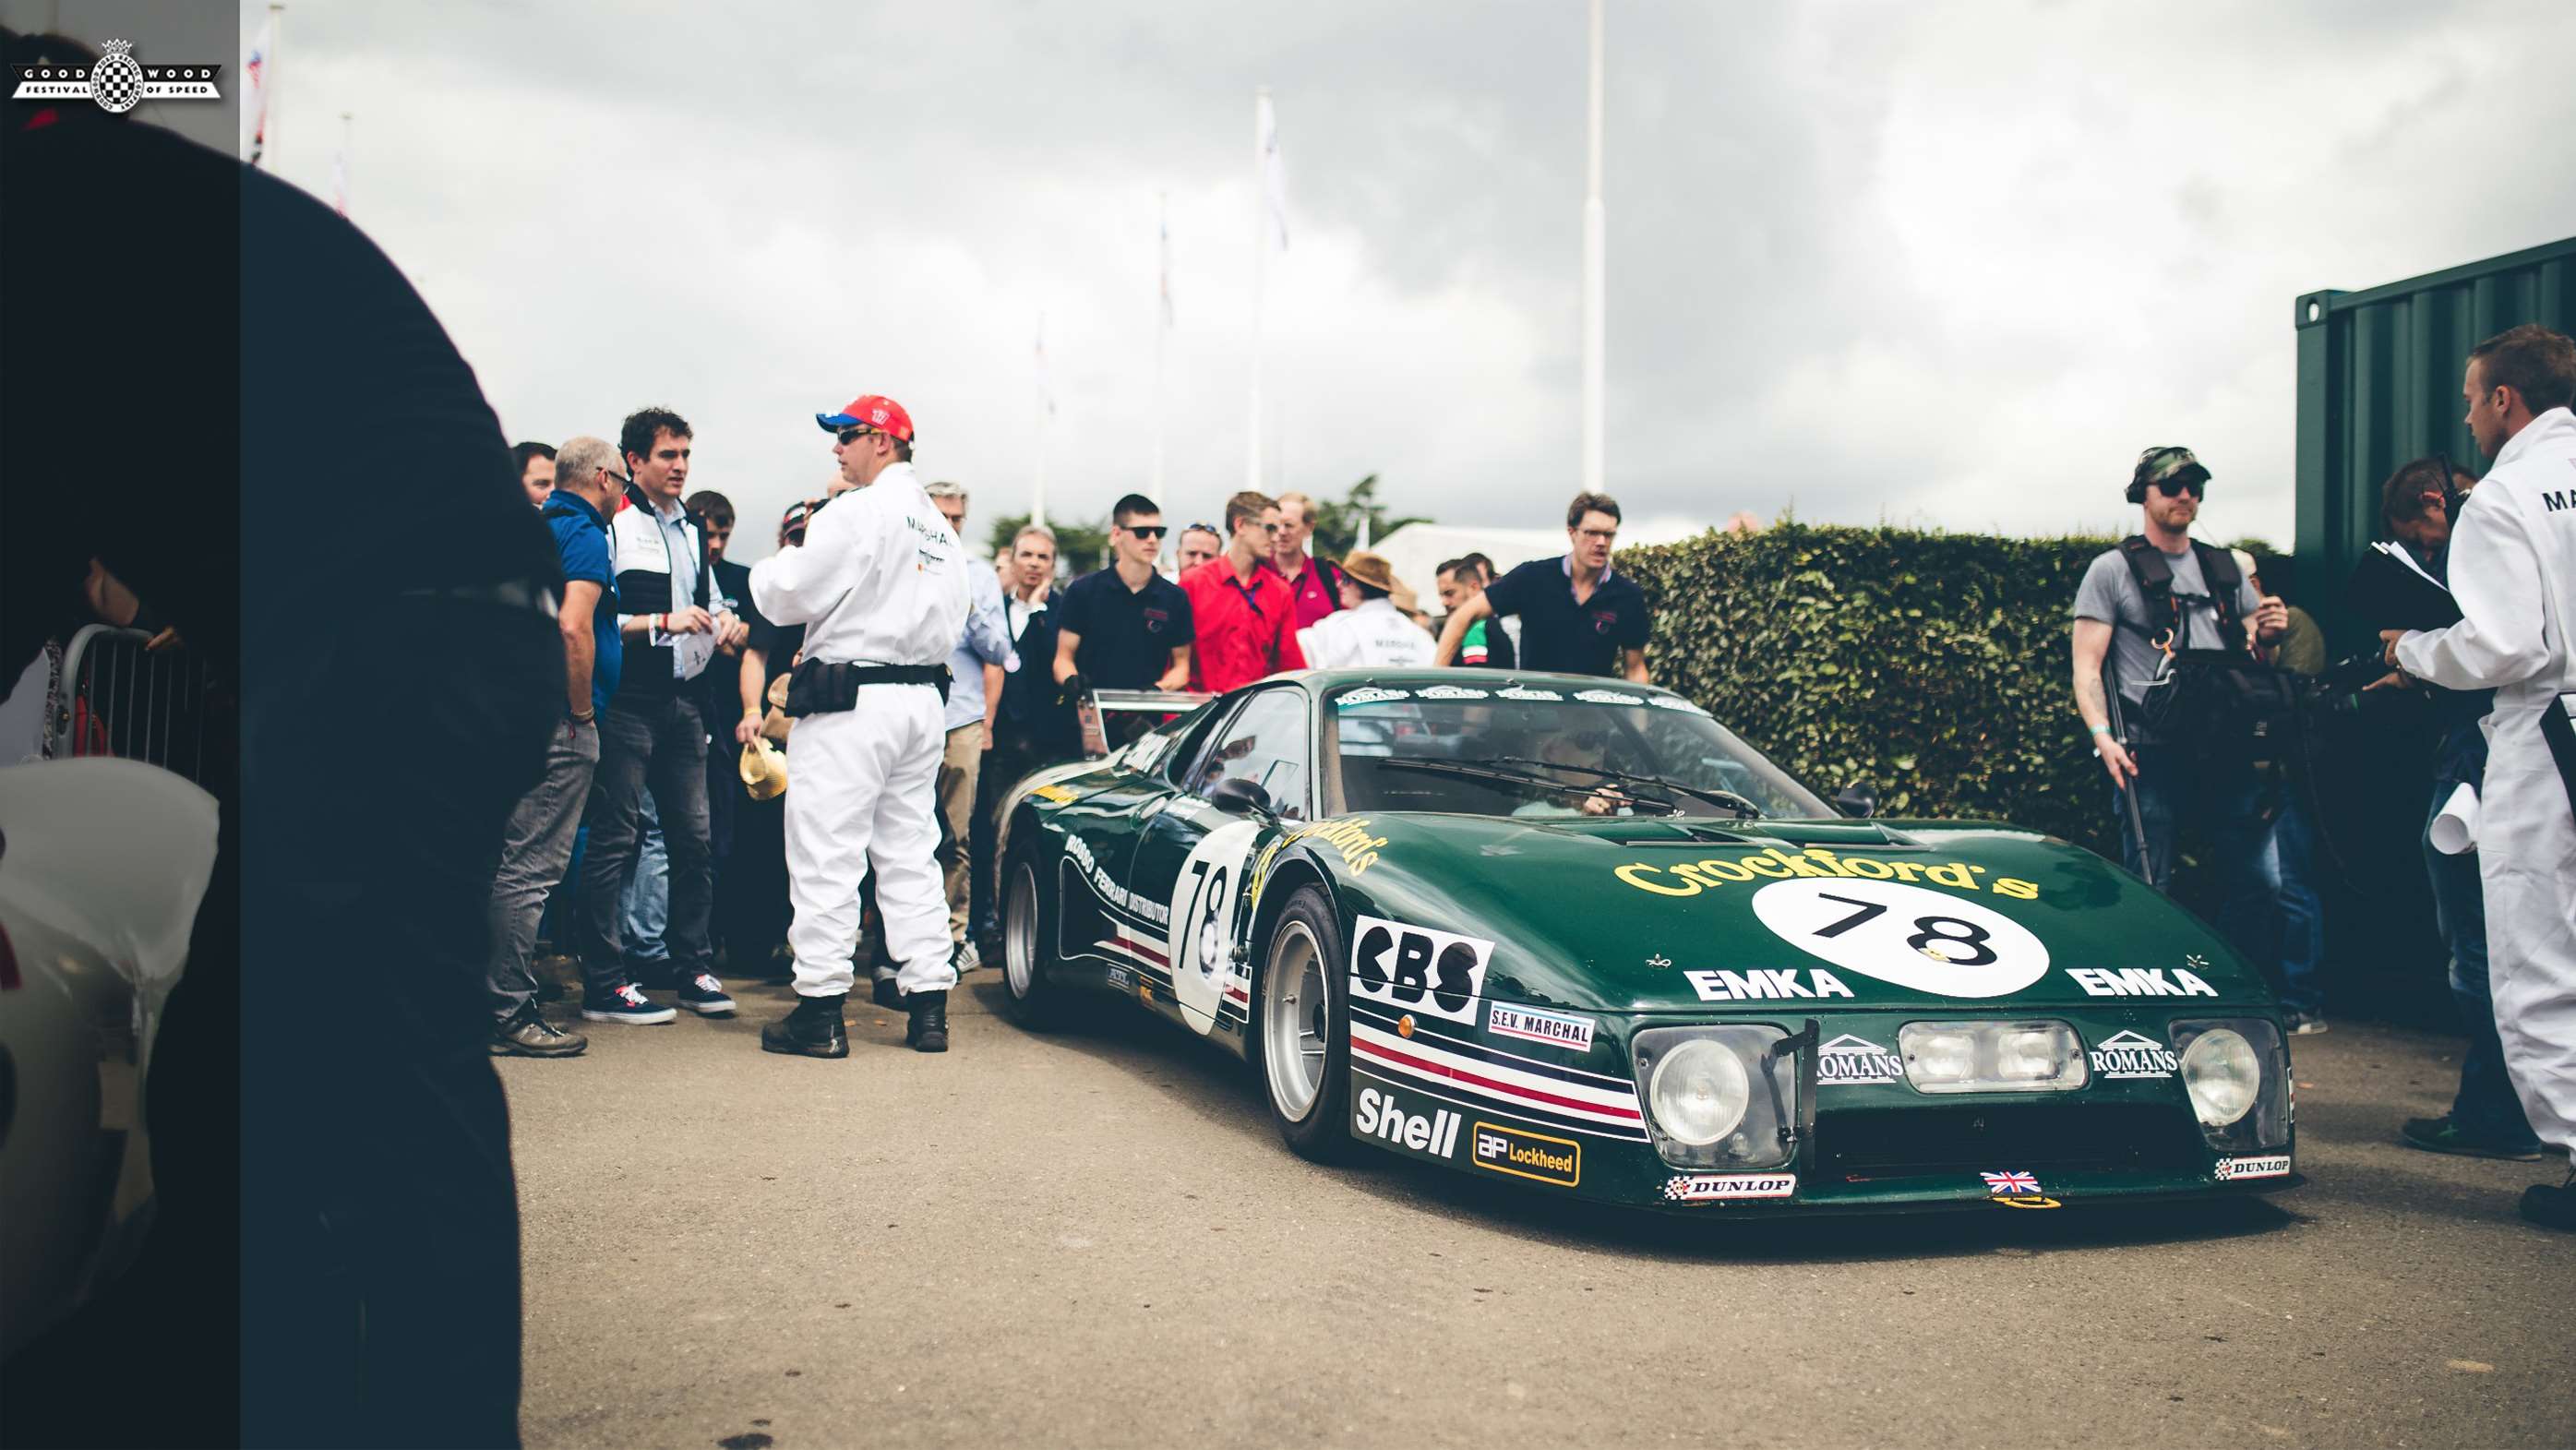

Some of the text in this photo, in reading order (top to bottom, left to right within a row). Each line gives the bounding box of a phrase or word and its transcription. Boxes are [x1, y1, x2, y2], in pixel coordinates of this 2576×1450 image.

[1065, 833, 1169, 926] ROSSO FERRARI DISTRIBUTOR
[1614, 848, 2040, 900] Crockford's
[1179, 859, 1228, 979] 78
[1812, 893, 1998, 966] 78
[1357, 926, 1479, 1013] CBS
[1683, 968, 1855, 1001] EMKA
[2065, 968, 2219, 997] EMKA
[1492, 1010, 1588, 1043] S.E.V. MARCHAL
[1816, 1053, 1904, 1078] OMANS
[2090, 1049, 2178, 1072] ROMANS
[1356, 1087, 1462, 1159] Shell
[1509, 1144, 1573, 1173] Lockheed
[2234, 1160, 2289, 1174] DUNLOP
[1693, 1180, 1791, 1193] DUNLOP
